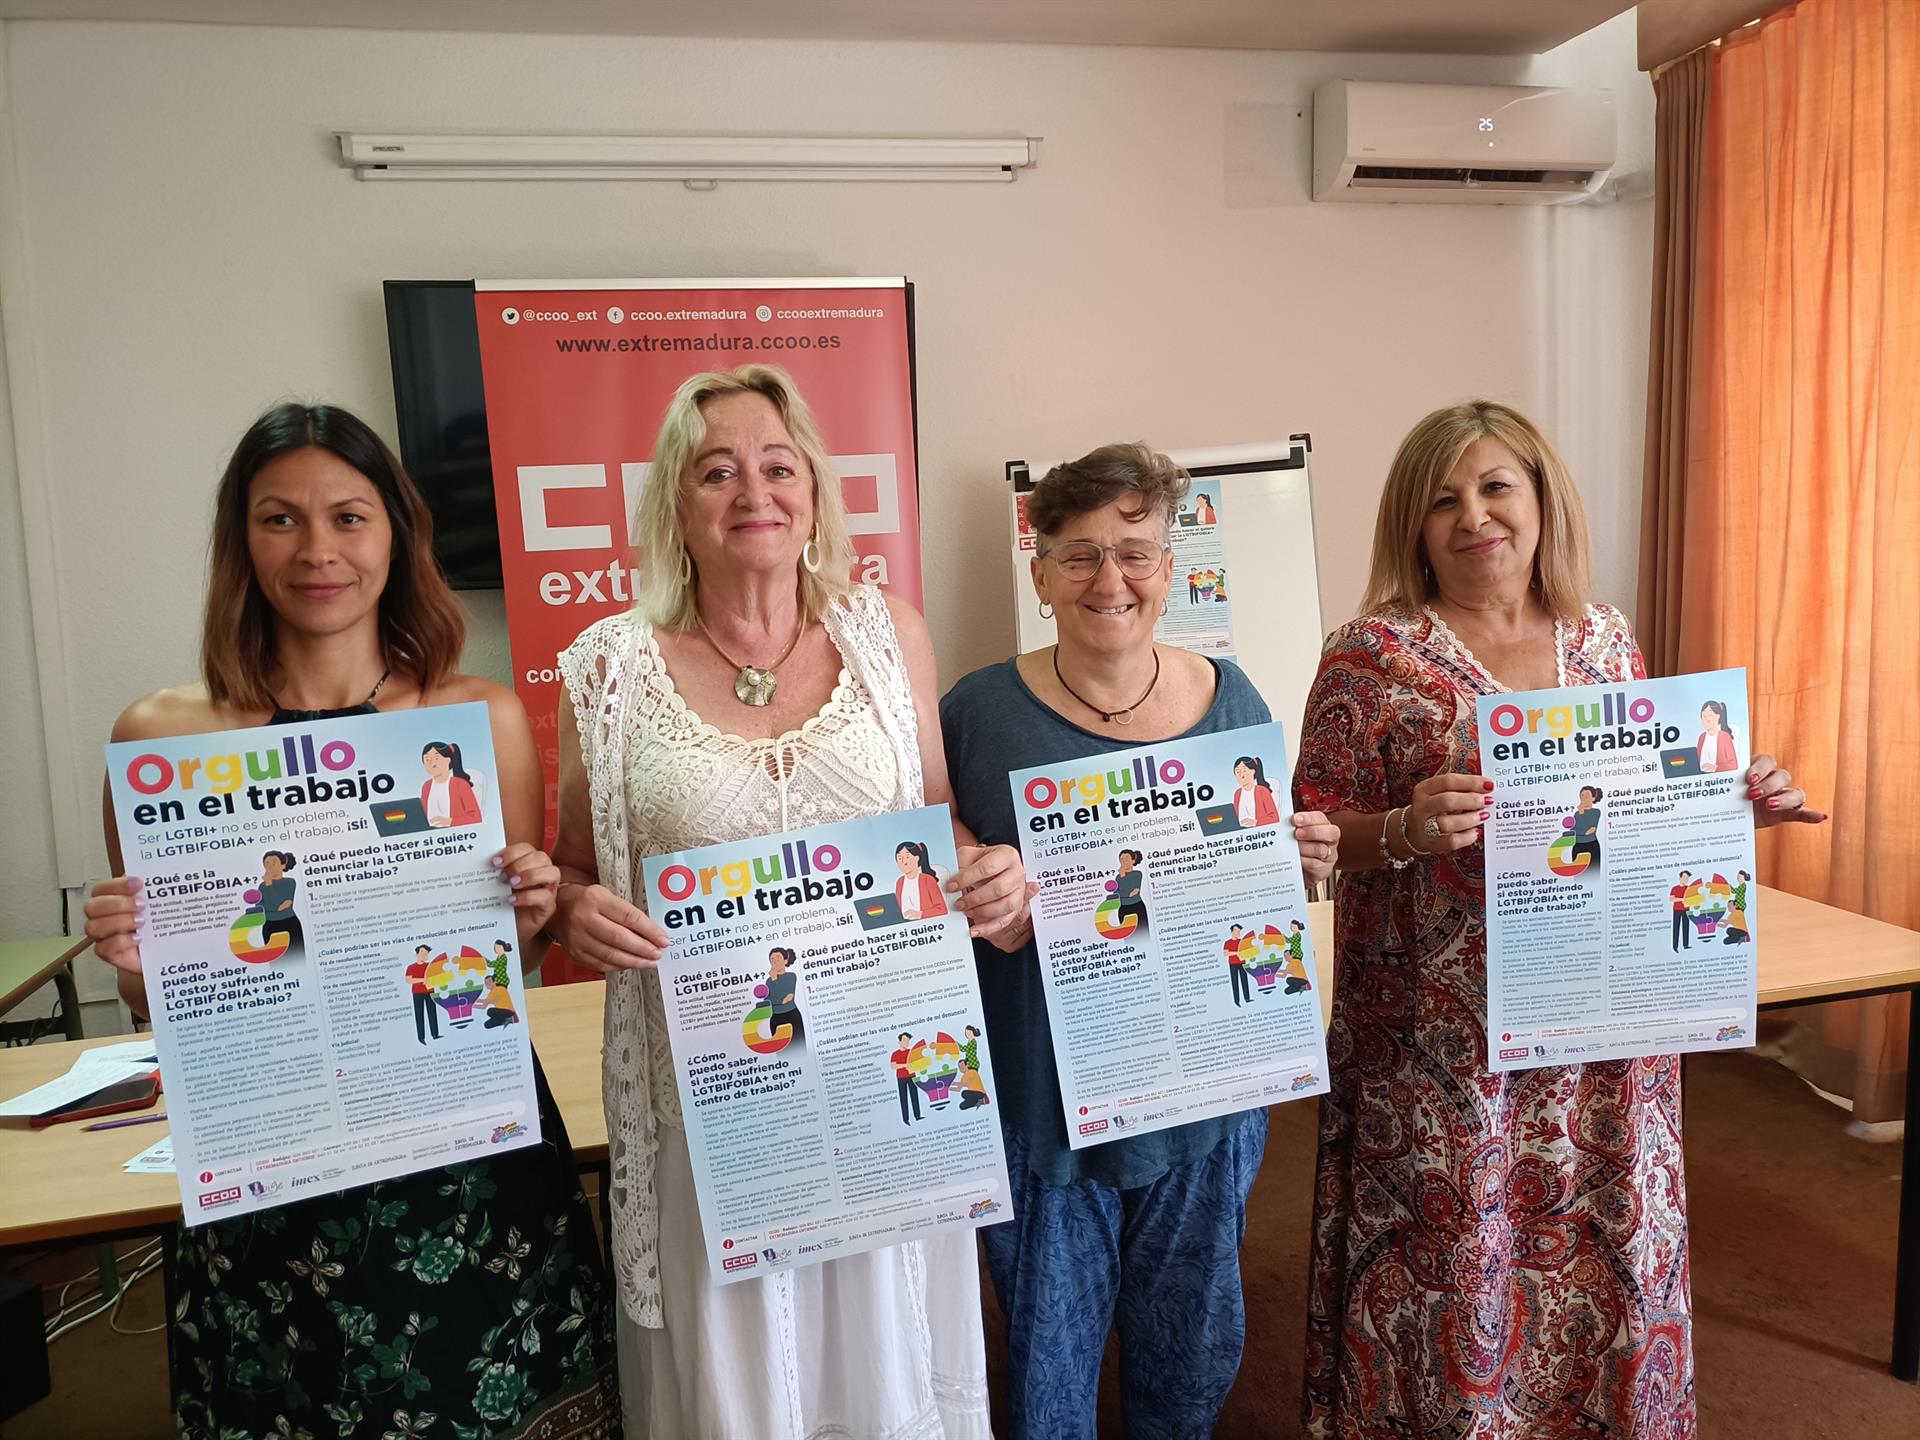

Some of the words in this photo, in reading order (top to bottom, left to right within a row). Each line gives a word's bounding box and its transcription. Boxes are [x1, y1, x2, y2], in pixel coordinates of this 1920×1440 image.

[1479, 118, 1493, 131] 25
[523, 309, 598, 323] @ccoo_ext
[630, 308, 747, 320] ccoo.extremadura
[776, 307, 884, 319] ccooextremadura
[556, 333, 841, 352] www.extremadura.ccoo.es
[1489, 692, 1655, 738] Orgullo
[1492, 741, 1530, 761] en
[1539, 737, 1565, 757] el
[1574, 722, 1680, 753] trabajo
[126, 734, 356, 795] Orgullo
[1494, 767, 1512, 776] Ser
[1514, 763, 1551, 774] LGTBI+
[1553, 762, 1567, 771] no
[1568, 761, 1580, 769] es
[1582, 759, 1595, 768] un
[1597, 754, 1645, 767] problema,
[1495, 780, 1505, 789] la
[1507, 773, 1576, 787] LGTBIFOBIA+
[1578, 772, 1591, 780] en
[1593, 769, 1602, 778] el
[1604, 767, 1640, 778] trabajo,
[1024, 755, 1186, 809] Orgullo
[133, 800, 185, 826] en
[198, 792, 235, 817] el
[246, 769, 394, 811] trabajo
[1029, 812, 1065, 833] en
[1073, 804, 1100, 825] el
[1107, 781, 1215, 819] trabajo
[137, 834, 161, 845] Ser
[165, 826, 217, 841] LGTBI+
[221, 824, 240, 834] no
[242, 821, 258, 831] es
[261, 818, 279, 829] un
[282, 809, 349, 828] problema,
[140, 849, 153, 860] la
[156, 836, 255, 858] LGTBIFOBIA+
[259, 834, 276, 844] en
[279, 829, 291, 841] el
[294, 824, 344, 839] trabajo,
[347, 817, 368, 831] ¡SÍ!
[1032, 838, 1049, 848] Ser
[1050, 831, 1087, 844] LGTBI+
[1089, 829, 1103, 837] no
[1104, 826, 1116, 835] es
[1118, 823, 1131, 832] un
[1132, 815, 1182, 831] problema,
[302, 850, 336, 864] ¿Qué
[339, 845, 381, 861] puedo
[383, 840, 420, 852] hacer
[423, 836, 434, 847] si
[436, 832, 477, 846] quiero
[1033, 850, 1043, 859] la
[1044, 838, 1114, 857] LGTBIFOBIA+
[1116, 836, 1129, 845] en
[1130, 832, 1139, 842] el
[1141, 827, 1178, 840] trabajo,
[304, 860, 369, 876] denunciar
[372, 857, 384, 866] la
[387, 844, 474, 864] LGTBIFOBIA+
[658, 840, 842, 902] Orgullo
[144, 872, 181, 887] ¿Qué
[184, 872, 200, 881] es
[203, 869, 216, 879] la
[146, 876, 258, 900] LGTBIFOBIA+?
[306, 879, 323, 888] en
[325, 874, 342, 885] mi
[345, 866, 399, 882] trabajo?
[664, 905, 706, 929] en
[715, 895, 746, 919] el
[754, 869, 874, 912] trabajo
[668, 935, 687, 947] Ser
[689, 927, 731, 943] LGTBI+
[734, 924, 750, 934] no
[751, 920, 765, 930] es
[766, 917, 781, 928] un
[783, 906, 838, 926] problema,
[669, 951, 680, 961] la
[682, 935, 762, 958] LGTBIFOBIA+
[765, 932, 780, 942] en
[781, 927, 792, 938] el
[793, 921, 835, 936] trabajo,
[835, 913, 854, 927] ¡SÍ!
[801, 945, 829, 959] ¿Qué
[831, 938, 865, 954] puedo
[866, 932, 897, 945] hacer
[899, 928, 908, 938] si
[910, 923, 945, 937] quiero
[802, 952, 856, 970] denunciar
[857, 949, 868, 958] la
[870, 934, 943, 956] LGTBIFOBIA+
[160, 961, 209, 976] ¿Cómo
[162, 972, 206, 990] puedo
[210, 966, 248, 979] saber
[673, 971, 703, 985] ¿Qué
[705, 970, 718, 979] es
[720, 967, 731, 976] la
[804, 972, 818, 982] en
[820, 967, 834, 978] mi
[836, 957, 881, 975] trabajo?
[164, 989, 175, 1000] si
[179, 983, 217, 997] estoy
[221, 971, 285, 990] sufriendo
[165, 987, 260, 1011] LGTBIFOBIA+
[263, 984, 280, 993] en
[283, 978, 300, 990] mi
[675, 972, 766, 997] LGTBIFOBIA+?
[168, 1008, 213, 1023] centro
[216, 1003, 234, 1014] de
[237, 992, 292, 1010] trabajo?
[687, 1052, 727, 1066] ¿Cómo
[688, 1062, 725, 1078] puedo
[727, 1056, 758, 1069] saber
[1500, 1049, 1528, 1058] CCOO
[690, 1077, 700, 1087] si
[702, 1072, 734, 1084] estoy
[736, 1060, 789, 1078] sufriendo
[692, 1075, 769, 1097] LGTBIFOBIA+
[771, 1072, 786, 1081] en
[788, 1066, 802, 1078] mi
[694, 1094, 731, 1108] centro
[733, 1089, 748, 1100] de
[750, 1079, 796, 1096] trabajo?
[1079, 1121, 1108, 1132] CCOO
[200, 1188, 241, 1205] CCOO
[723, 1254, 757, 1269] CCOO
